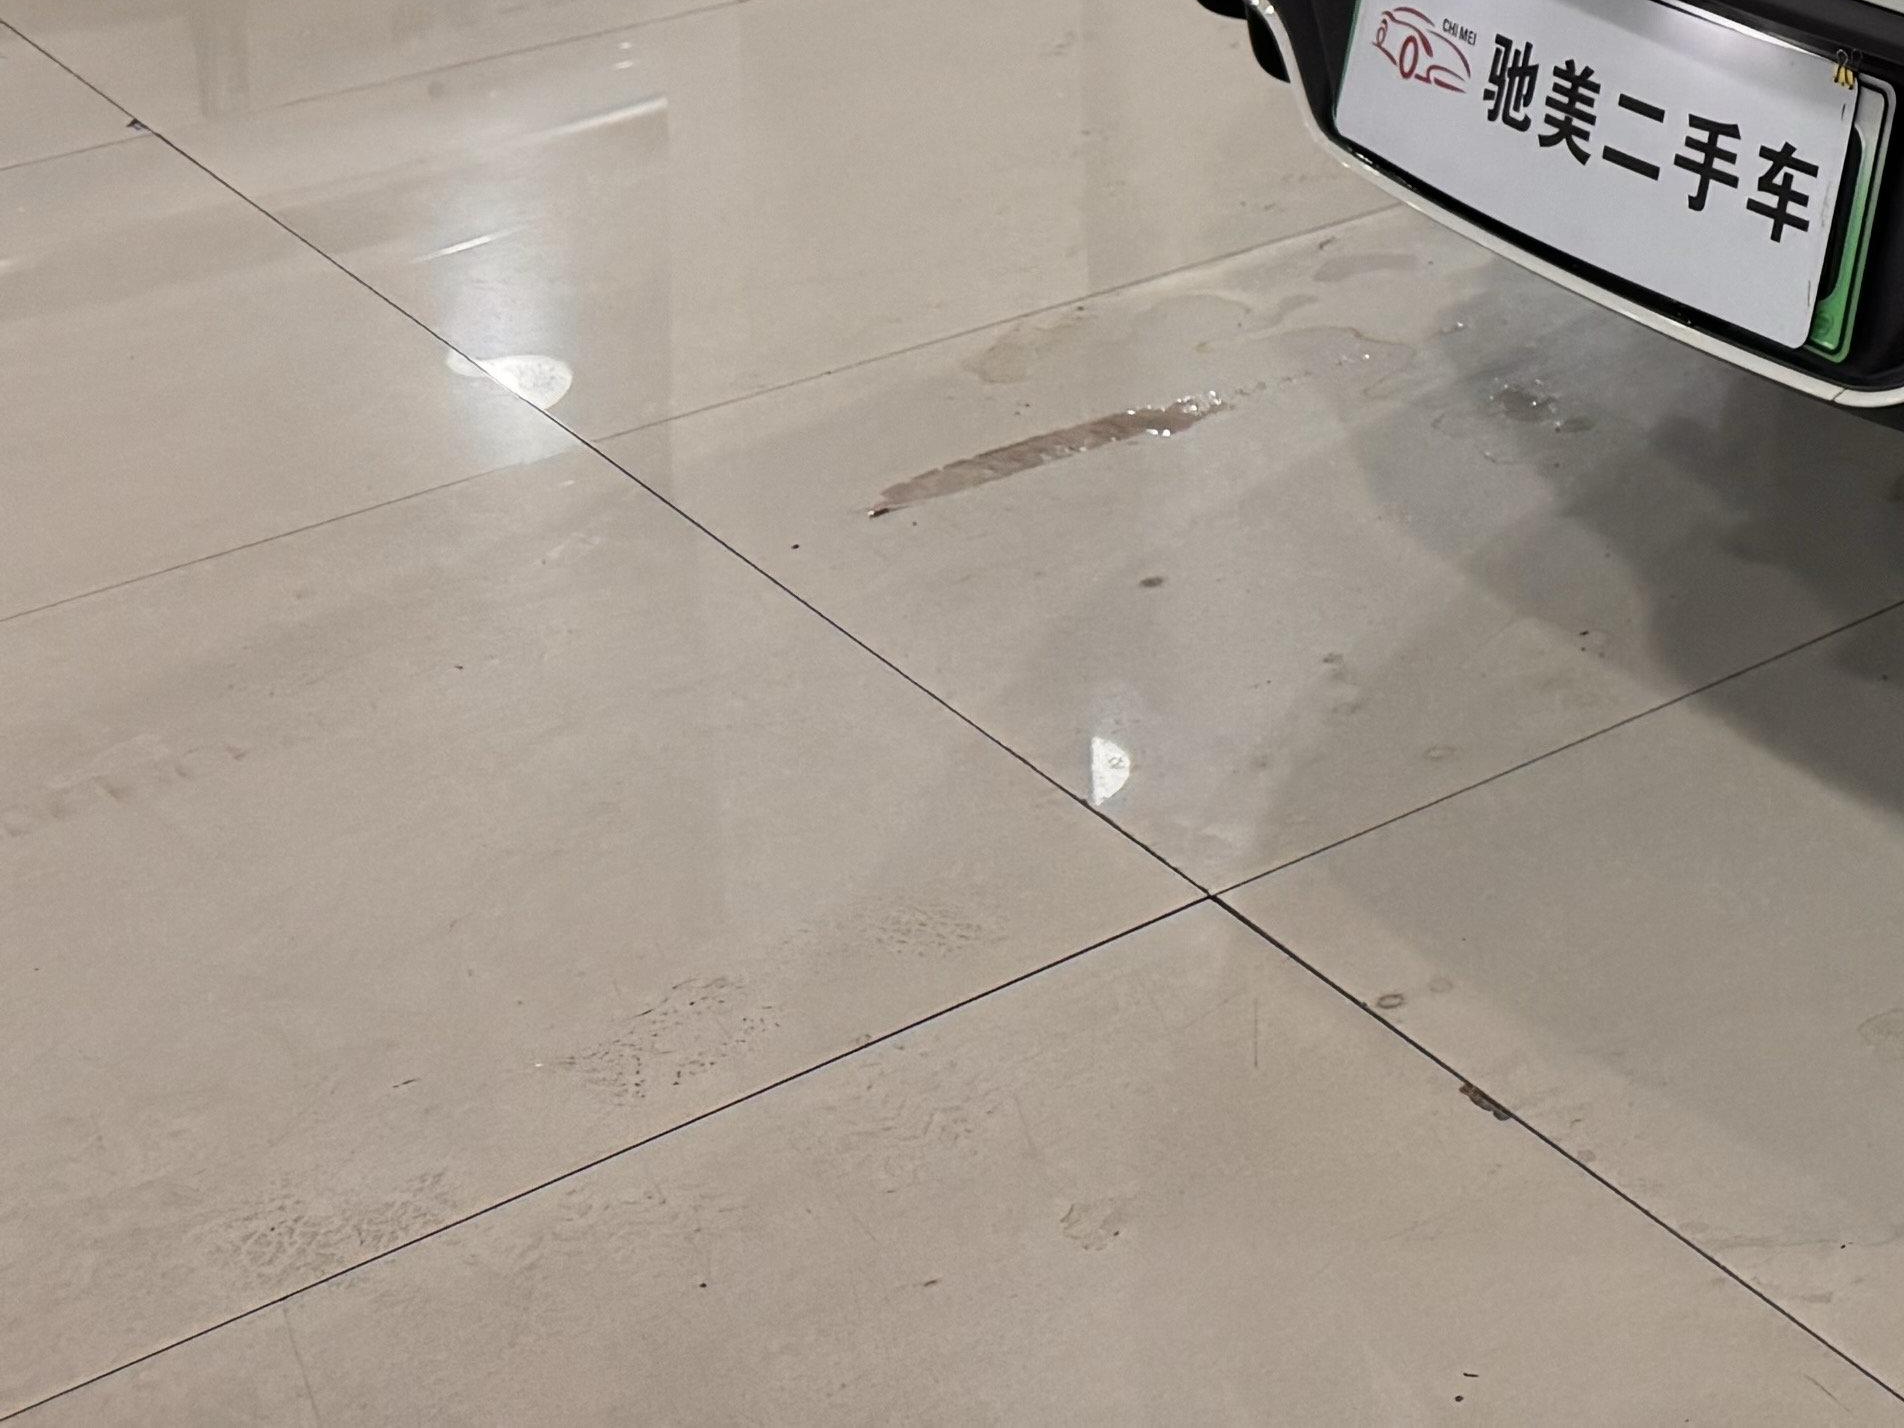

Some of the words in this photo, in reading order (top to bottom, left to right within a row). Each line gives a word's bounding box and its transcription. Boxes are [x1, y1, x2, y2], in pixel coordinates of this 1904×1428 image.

[1482, 32, 1820, 244] 驰美二手车
